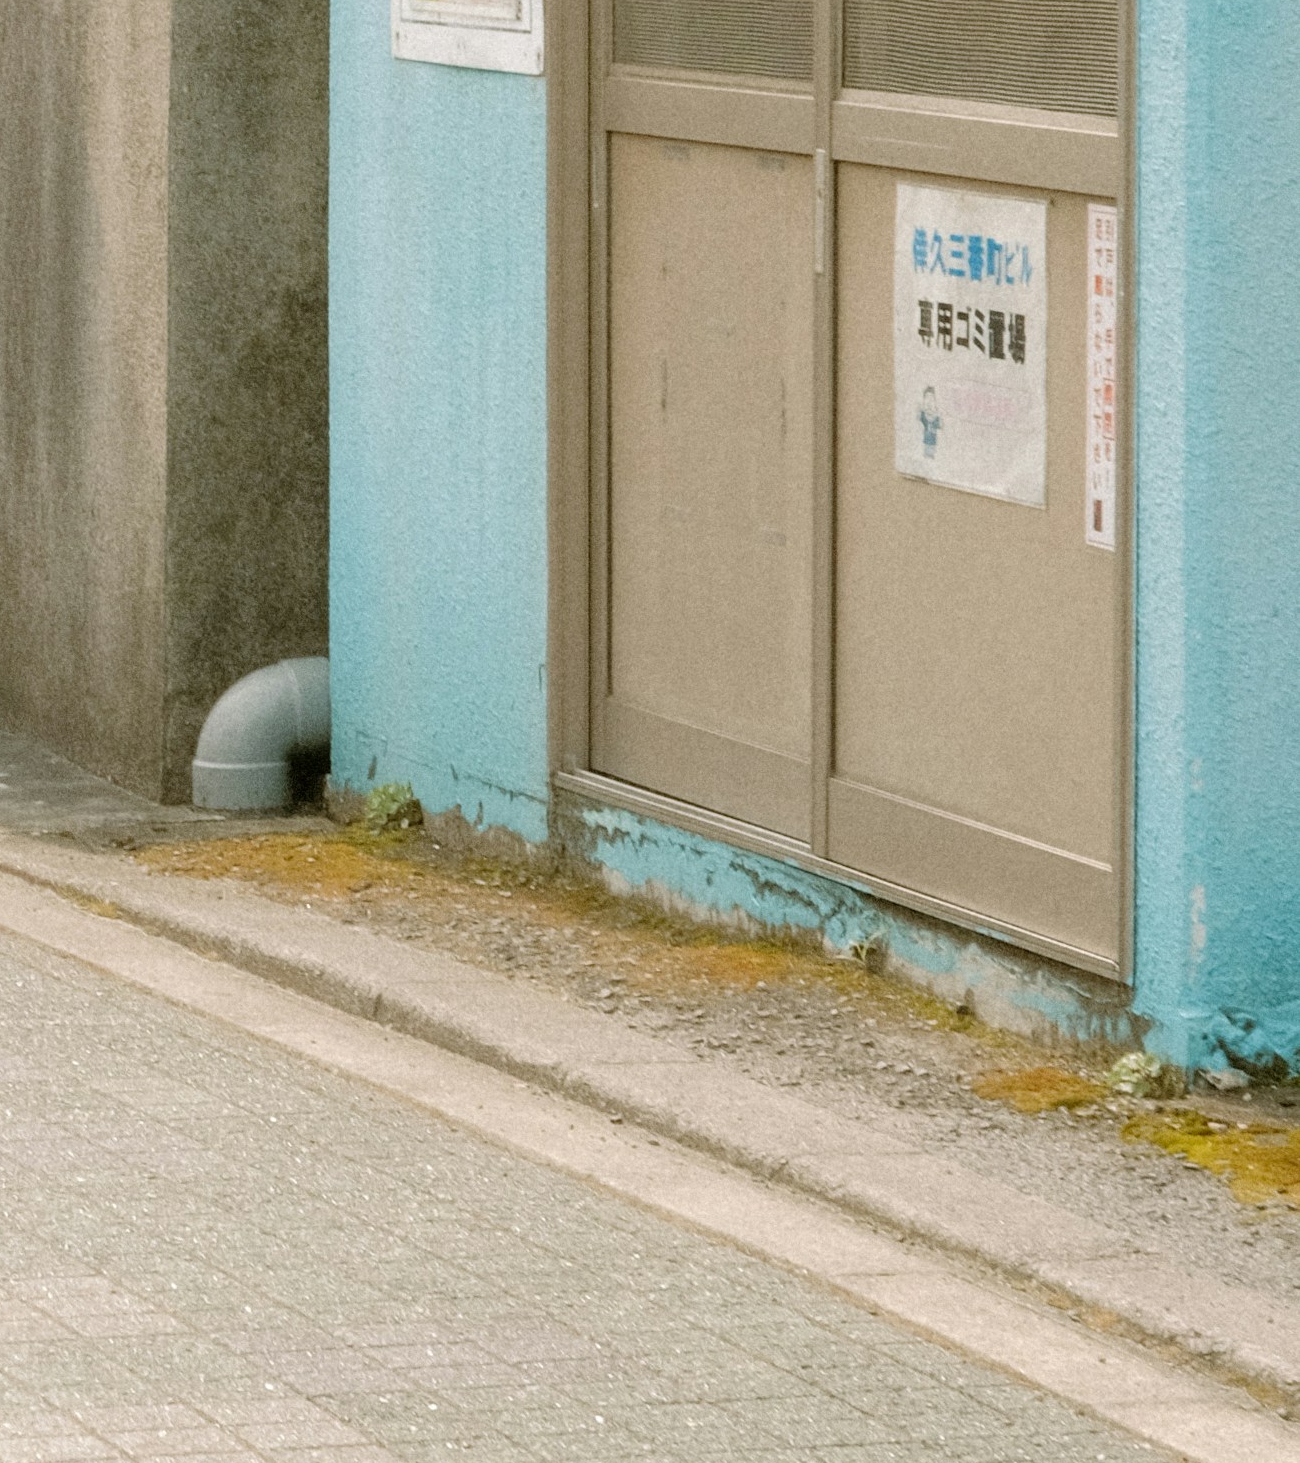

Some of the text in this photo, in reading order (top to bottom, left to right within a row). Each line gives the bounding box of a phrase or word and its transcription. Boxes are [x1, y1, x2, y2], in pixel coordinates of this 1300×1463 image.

[918, 299, 1026, 365] 専用ゴミ置場
